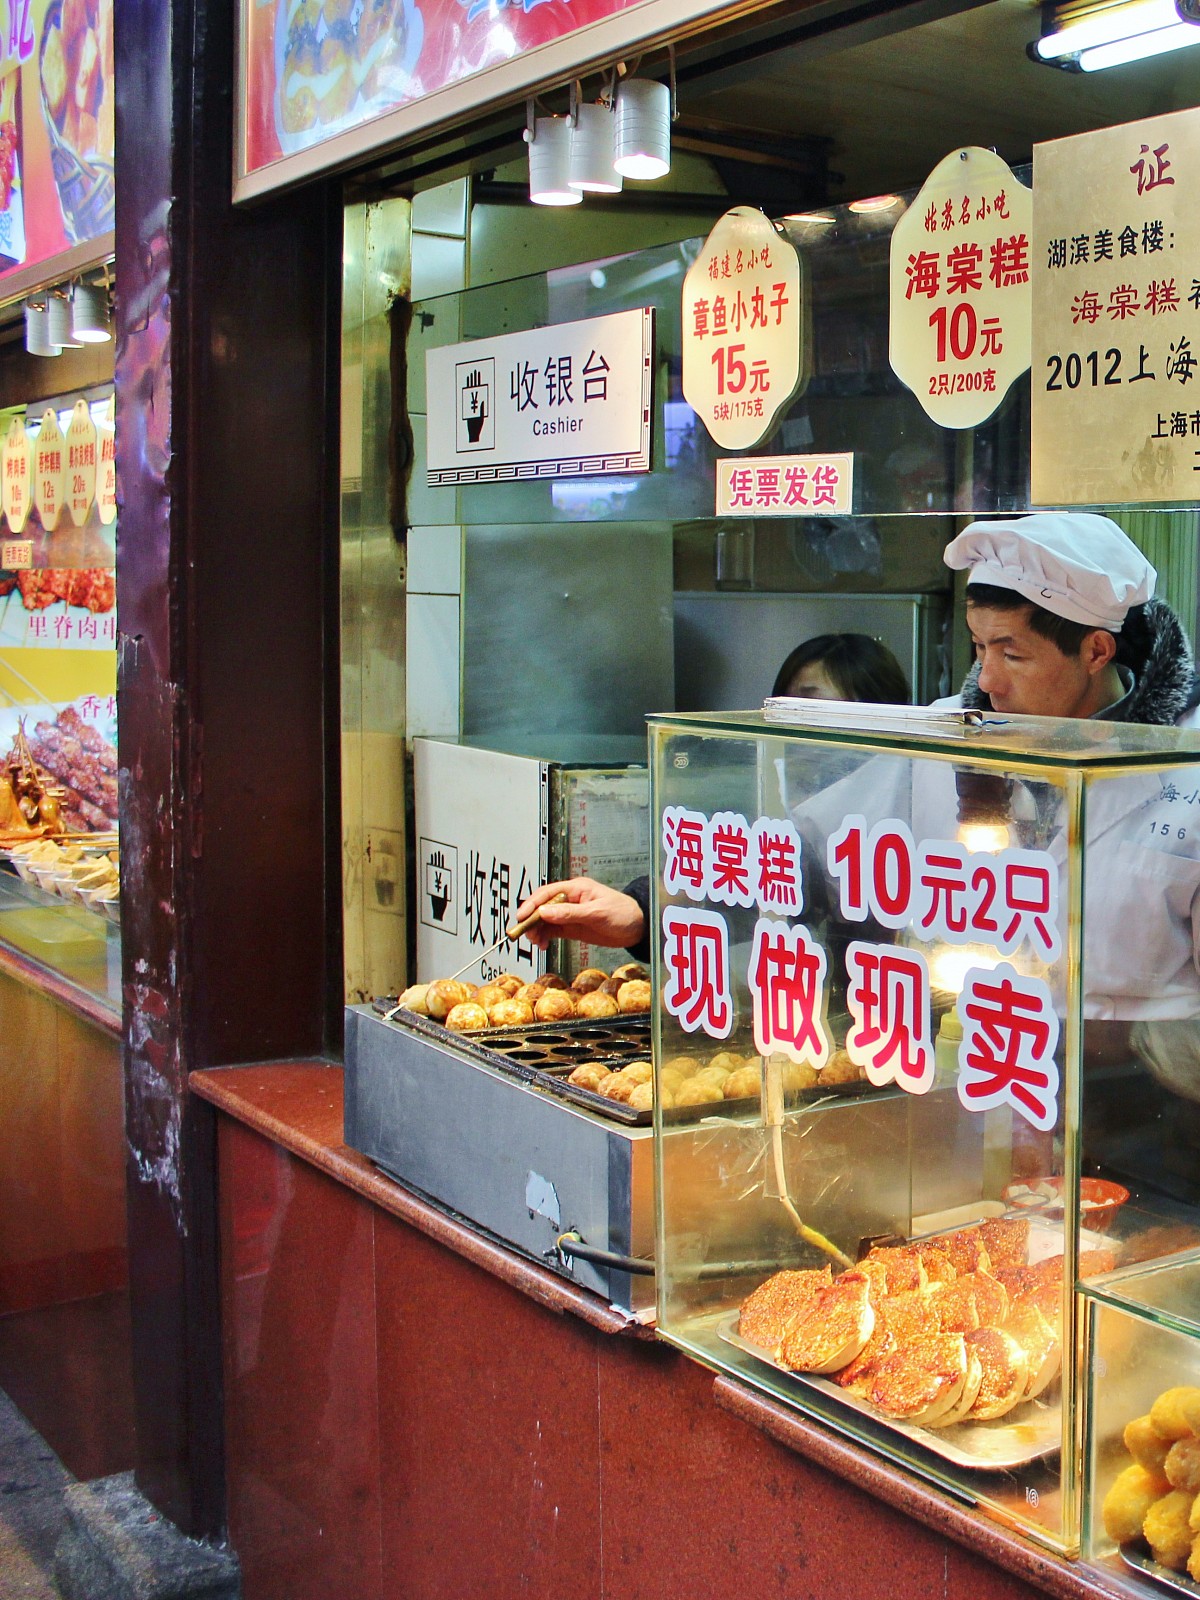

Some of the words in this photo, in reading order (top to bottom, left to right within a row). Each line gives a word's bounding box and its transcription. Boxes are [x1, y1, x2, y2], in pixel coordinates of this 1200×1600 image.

[924, 189, 1011, 234] 姑苏名小吃
[708, 243, 773, 282] 福建名小吃
[904, 233, 1030, 301] 海棠糕
[692, 281, 790, 341] 章鱼小丸子
[928, 302, 1004, 363] 10元
[509, 349, 611, 412] 收银台
[710, 343, 771, 396] 15元
[928, 367, 997, 396] 2只/200克
[532, 416, 584, 436] Cashier
[712, 396, 764, 422] 5块/175克
[728, 465, 840, 508] 凭票发货
[1149, 821, 1187, 840] 156
[465, 849, 533, 968] 收银台
[666, 816, 798, 906] 海棠糕
[834, 827, 1053, 950] 10元2只
[669, 921, 1051, 1121] 现做现卖
